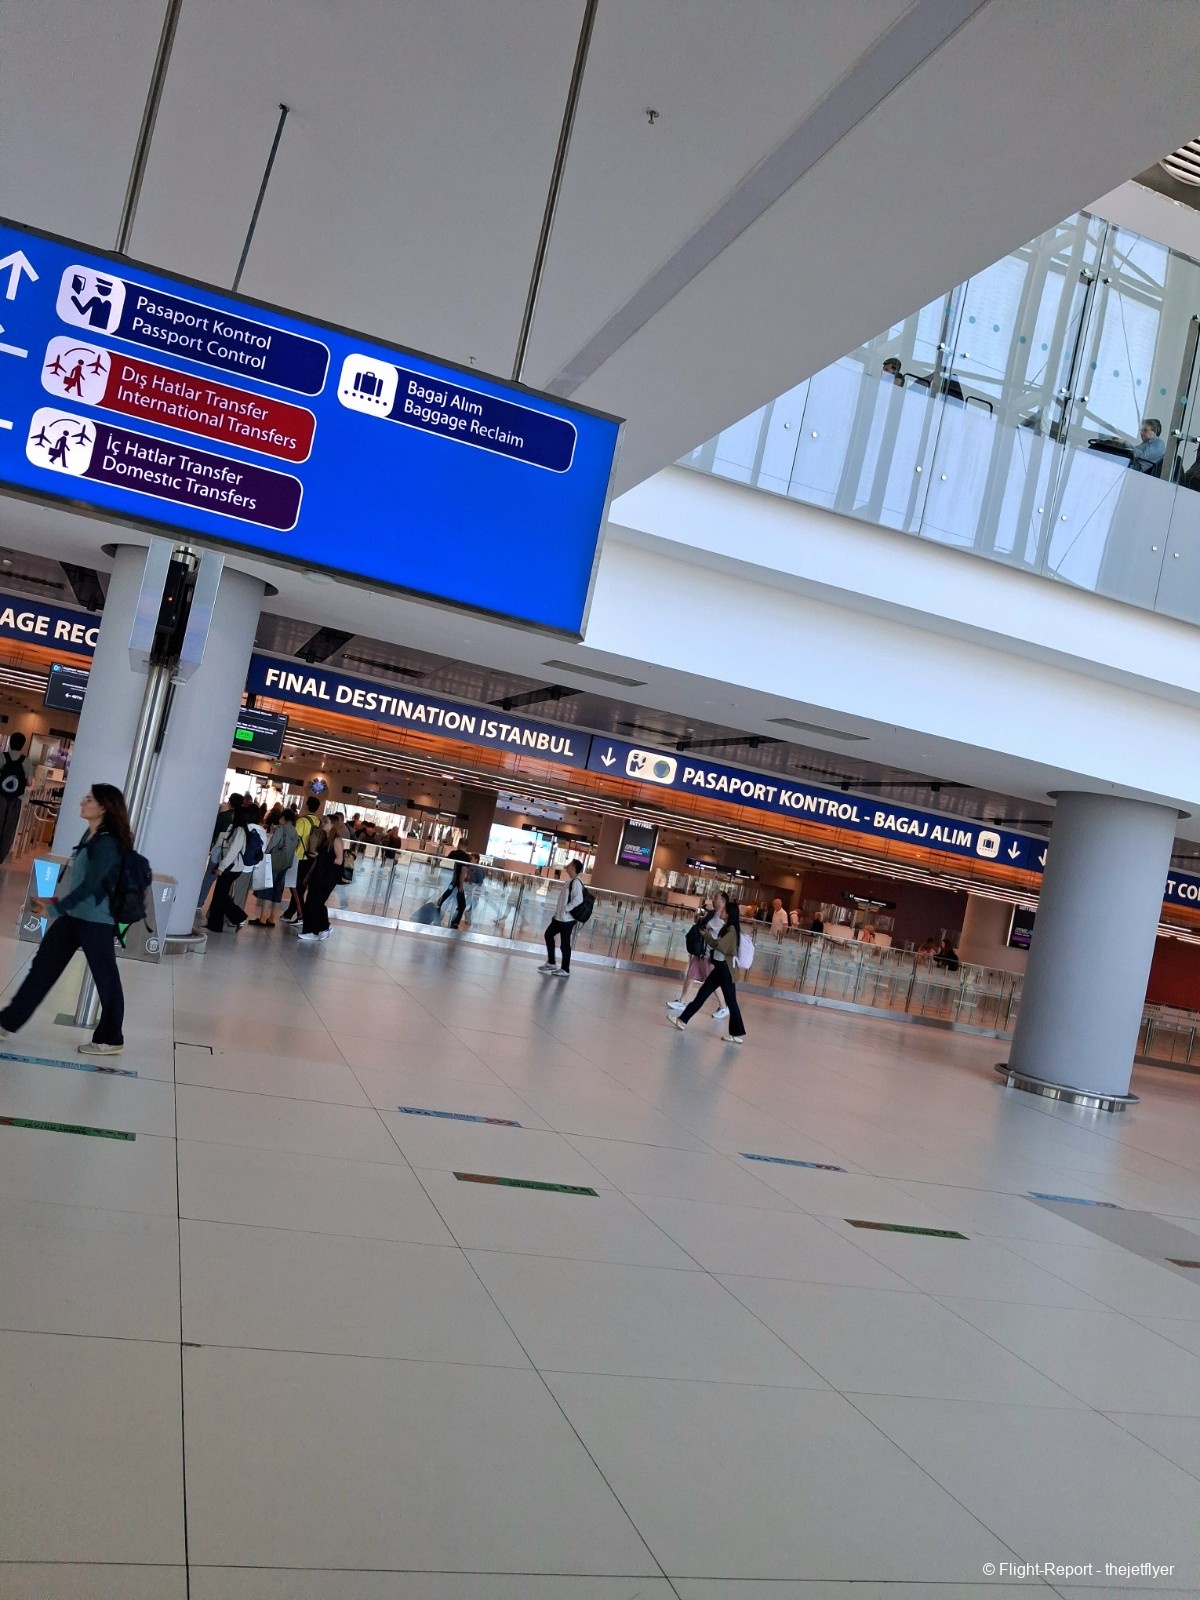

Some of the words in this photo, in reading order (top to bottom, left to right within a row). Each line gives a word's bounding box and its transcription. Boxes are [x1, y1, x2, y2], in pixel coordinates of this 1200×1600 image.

[132, 316, 203, 351] Passport
[206, 340, 266, 370] Control
[136, 295, 209, 331] Pasaport
[212, 320, 272, 350] Kontrol
[117, 385, 225, 428] International
[227, 416, 297, 450] Transfers
[121, 365, 148, 390] Dış
[152, 374, 202, 401] Hatlar
[205, 389, 269, 421] Transfer
[407, 380, 448, 408] Bagaj
[449, 394, 483, 416] Alım
[404, 398, 467, 431] Baggage
[470, 419, 524, 448] Reclaim
[106, 432, 122, 457] İç
[124, 440, 176, 468] Hatlar
[179, 454, 244, 486] Transfer
[185, 477, 257, 511] Transfers
[265, 668, 330, 700] FINAL
[335, 685, 476, 734] DESTINATION
[479, 719, 574, 757] ISTANBUL
[682, 767, 778, 803] PASAPORT
[778, 789, 860, 823] KONTROL
[873, 811, 929, 838] BAGAJ
[929, 825, 972, 848] ALIM
